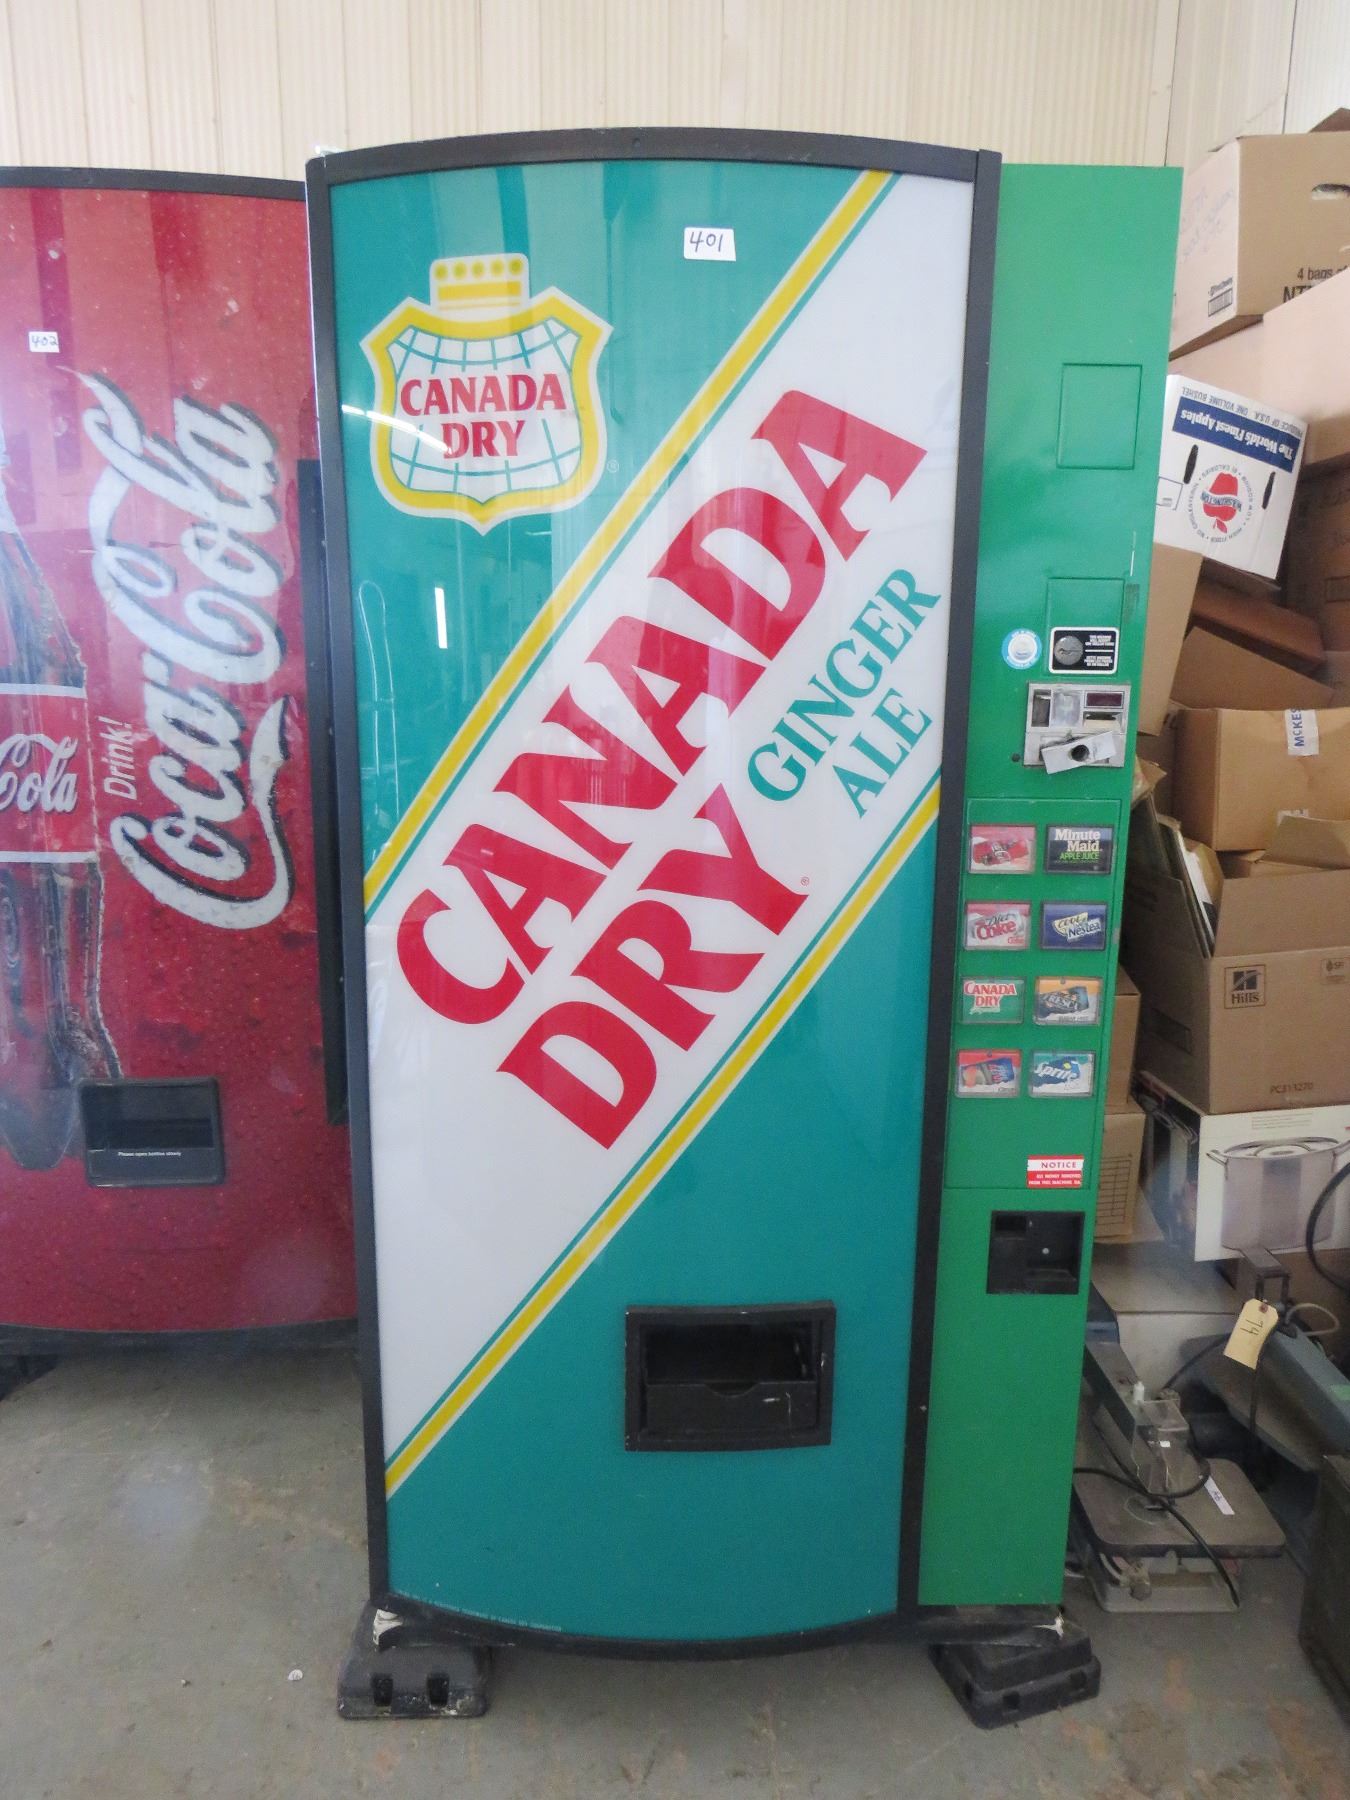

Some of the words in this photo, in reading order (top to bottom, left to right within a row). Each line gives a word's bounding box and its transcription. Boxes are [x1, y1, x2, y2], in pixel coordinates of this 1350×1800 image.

[690, 231, 723, 252] 401
[31, 335, 57, 348] 402
[400, 373, 567, 417] CANADA
[1180, 409, 1216, 431] Apples
[1215, 420, 1246, 442] Finest
[441, 420, 526, 459] DRY
[1278, 443, 1294, 461] The
[55, 365, 293, 930] Coca-Cola
[748, 568, 942, 802] GINGER
[397, 390, 928, 1025] CANADA
[98, 715, 137, 800] Drink!
[833, 687, 933, 819] ALE
[1055, 828, 1101, 841] Minute
[1060, 851, 1081, 860] APPLE
[1082, 851, 1100, 860] JUICE
[1067, 840, 1101, 852] Maid
[496, 782, 809, 1151] DRY
[964, 982, 1015, 995] CANADA
[975, 995, 999, 1007] DRY
[1041, 1161, 1077, 1169] NOTICE
